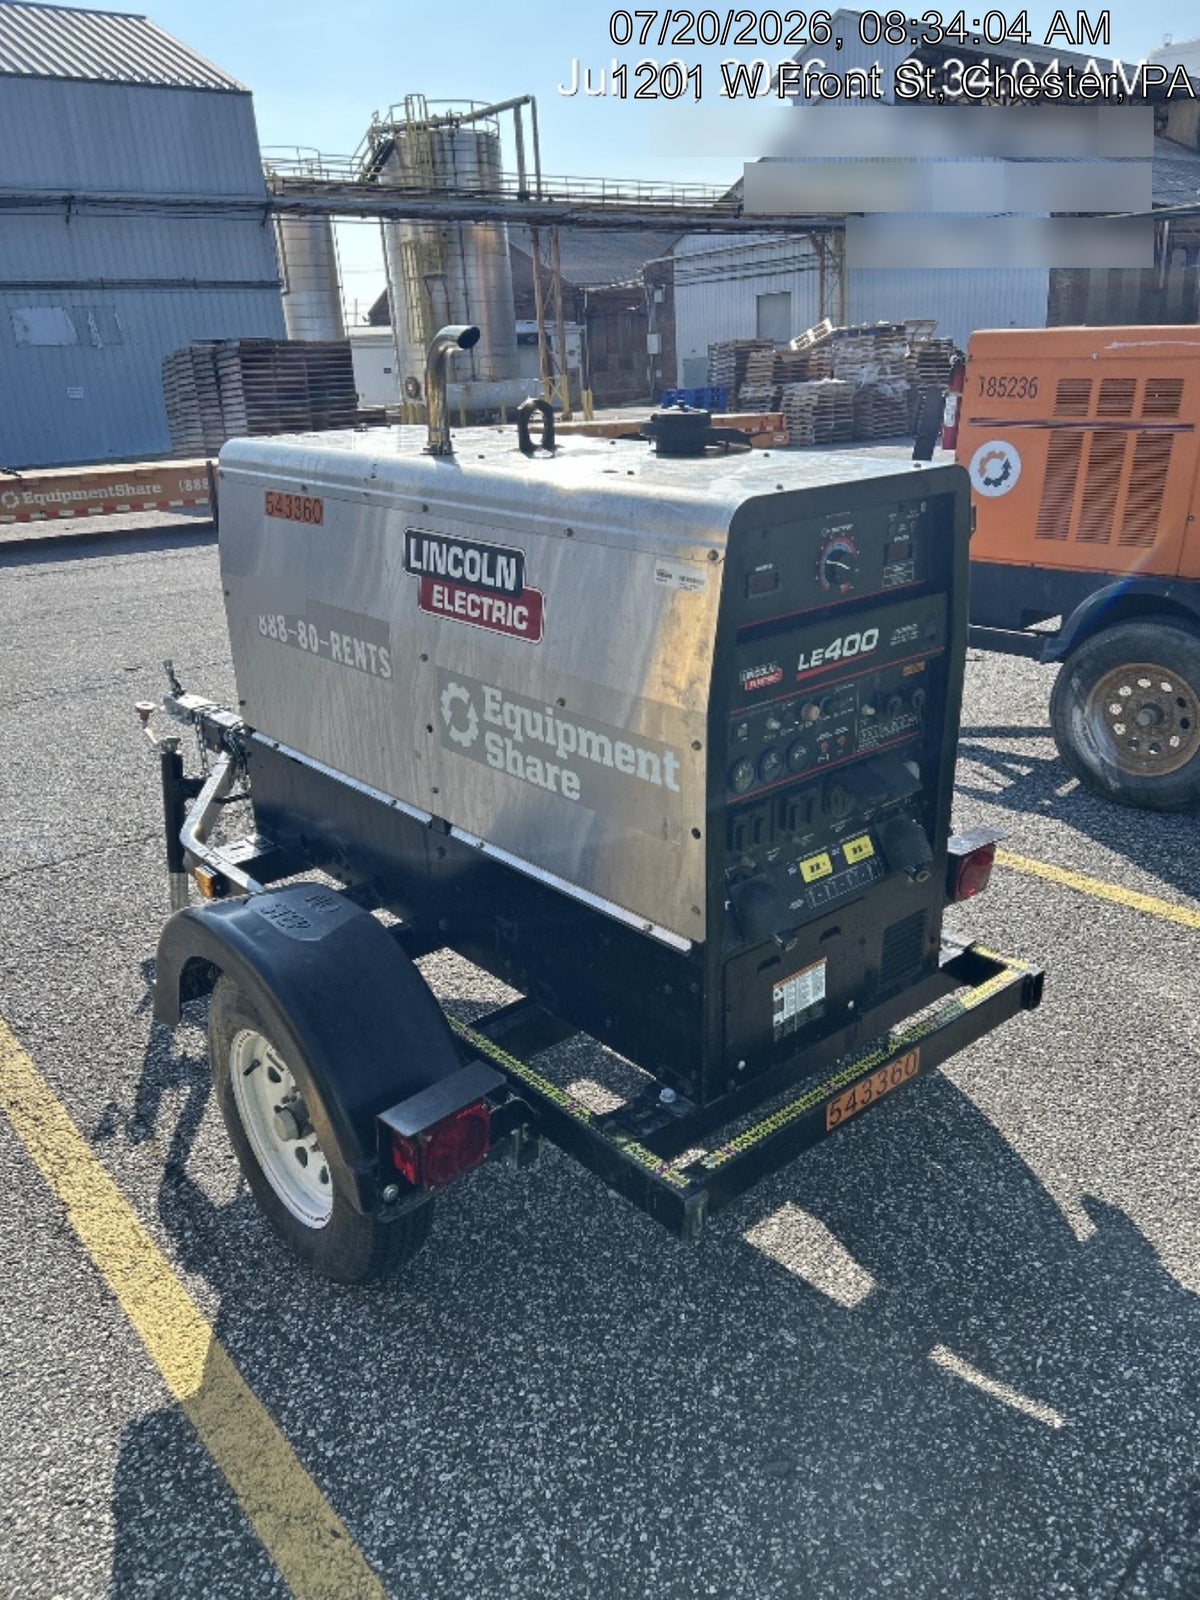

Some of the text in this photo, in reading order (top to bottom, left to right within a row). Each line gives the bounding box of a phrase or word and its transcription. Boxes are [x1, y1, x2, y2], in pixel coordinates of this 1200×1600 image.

[22, 482, 162, 506] EquipmentShare
[265, 491, 323, 524] 543360
[409, 537, 517, 591] LINCOLN
[431, 584, 529, 630] ELECTRIC
[798, 628, 880, 671] LE400
[481, 684, 681, 792] Equipment
[484, 730, 581, 800] Share
[828, 1051, 918, 1126] 543360
